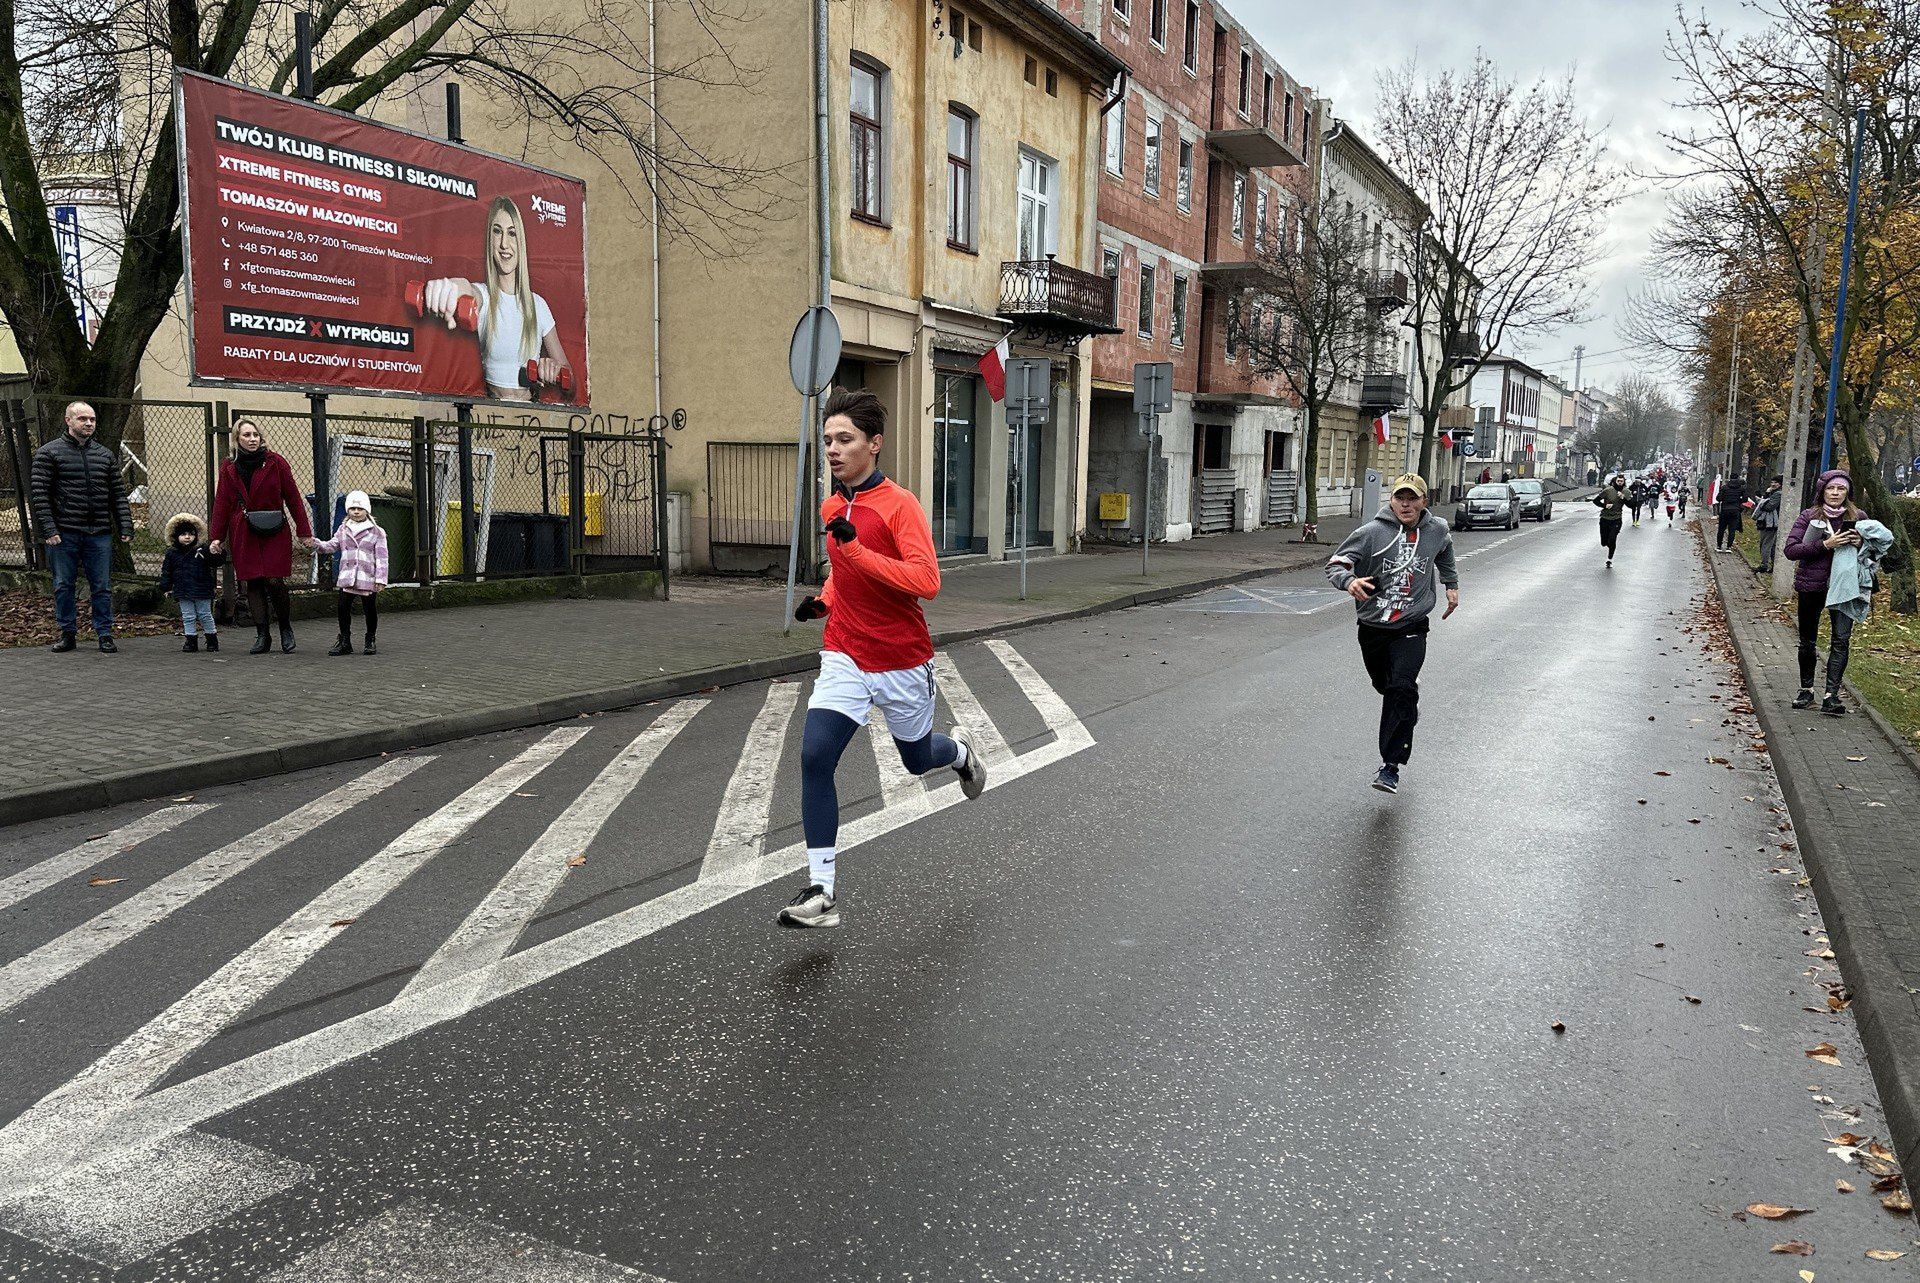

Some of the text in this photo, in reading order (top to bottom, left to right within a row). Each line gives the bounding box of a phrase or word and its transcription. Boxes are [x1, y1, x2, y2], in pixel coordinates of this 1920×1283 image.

[217, 121, 476, 198] TWÓJ KLUB FITNESS I SIŁOWNIA
[219, 155, 382, 203] XTREME FITNESS GYMS
[220, 187, 397, 234] TOMASZÓW MAZOWIECKI
[531, 194, 566, 215] XTREME
[237, 221, 433, 265] Kwiatowa 2/8, 97-200 Tomaszów Mazowiecki
[238, 242, 318, 263] +48 571 485 360
[240, 261, 355, 286] xfgtomaszowmazowiecki
[240, 281, 360, 306] xfg_tomaszowmazowiecki
[229, 312, 306, 334] PRZYJDŹ
[326, 324, 409, 346] WYPRÓBUJ
[224, 346, 271, 360] RABATY
[274, 351, 296, 363] DLA
[298, 353, 350, 367] UCZNIÓW
[358, 357, 422, 374] STUDENTÓW!
